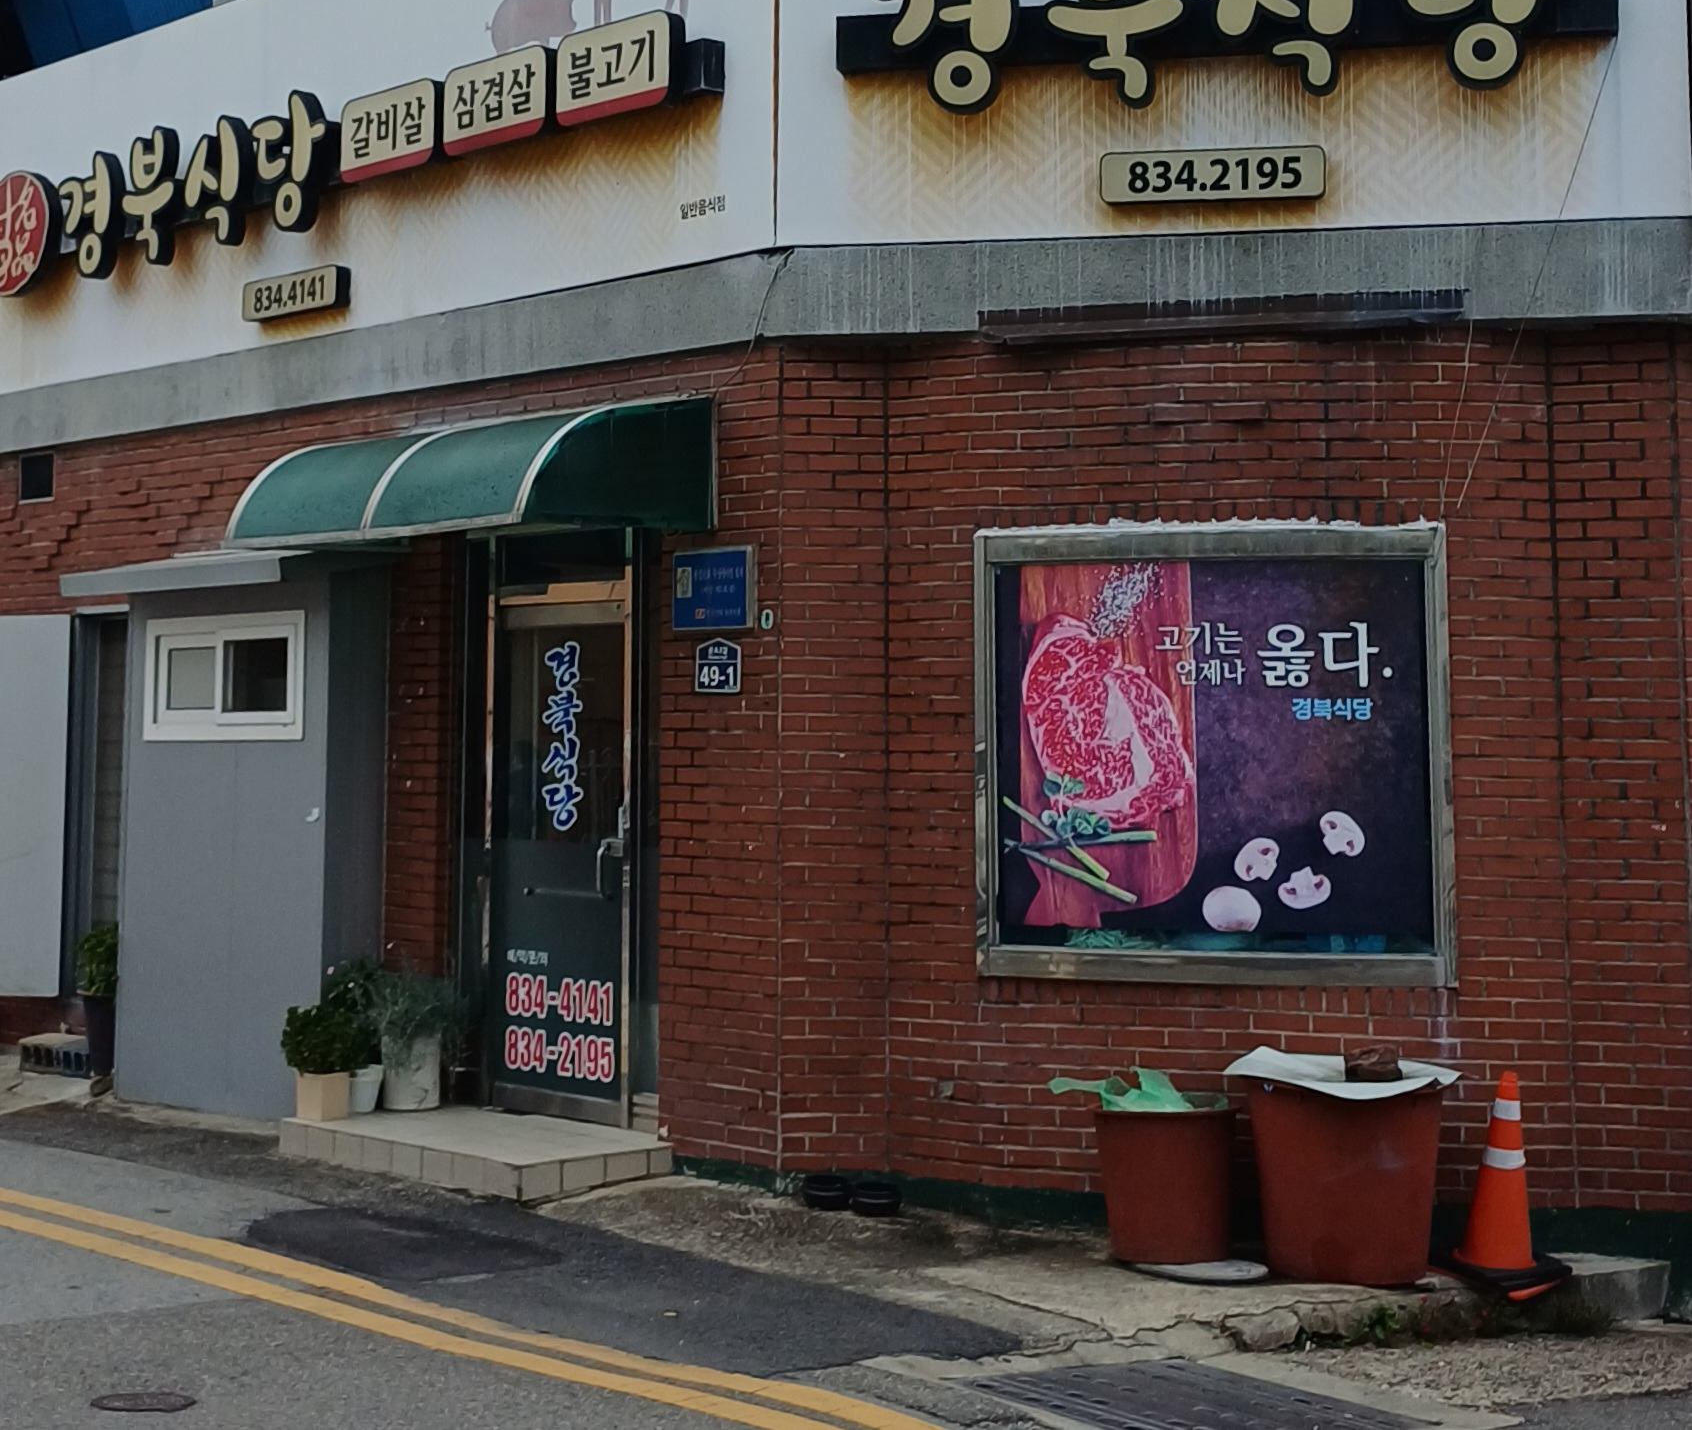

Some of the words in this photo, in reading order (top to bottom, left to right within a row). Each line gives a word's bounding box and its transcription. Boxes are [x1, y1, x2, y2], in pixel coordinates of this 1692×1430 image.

[567, 29, 656, 101] 불고기
[452, 63, 536, 130] 삼겹살
[350, 96, 426, 159] 갈비살
[57, 90, 326, 278] 경북식당
[1127, 155, 1302, 194] 834.2195
[679, 194, 726, 220] 일반음식점
[253, 274, 325, 313] 834.4141
[1155, 621, 1244, 655] 고기는
[1256, 621, 1394, 688] 옳다.
[699, 665, 734, 687] 49-1
[1175, 659, 1246, 687] 언제나
[542, 641, 584, 831] 경북식당
[1291, 697, 1374, 721] 경북식당
[506, 972, 613, 1026] 834-4141
[505, 1025, 615, 1083] 834-2195
